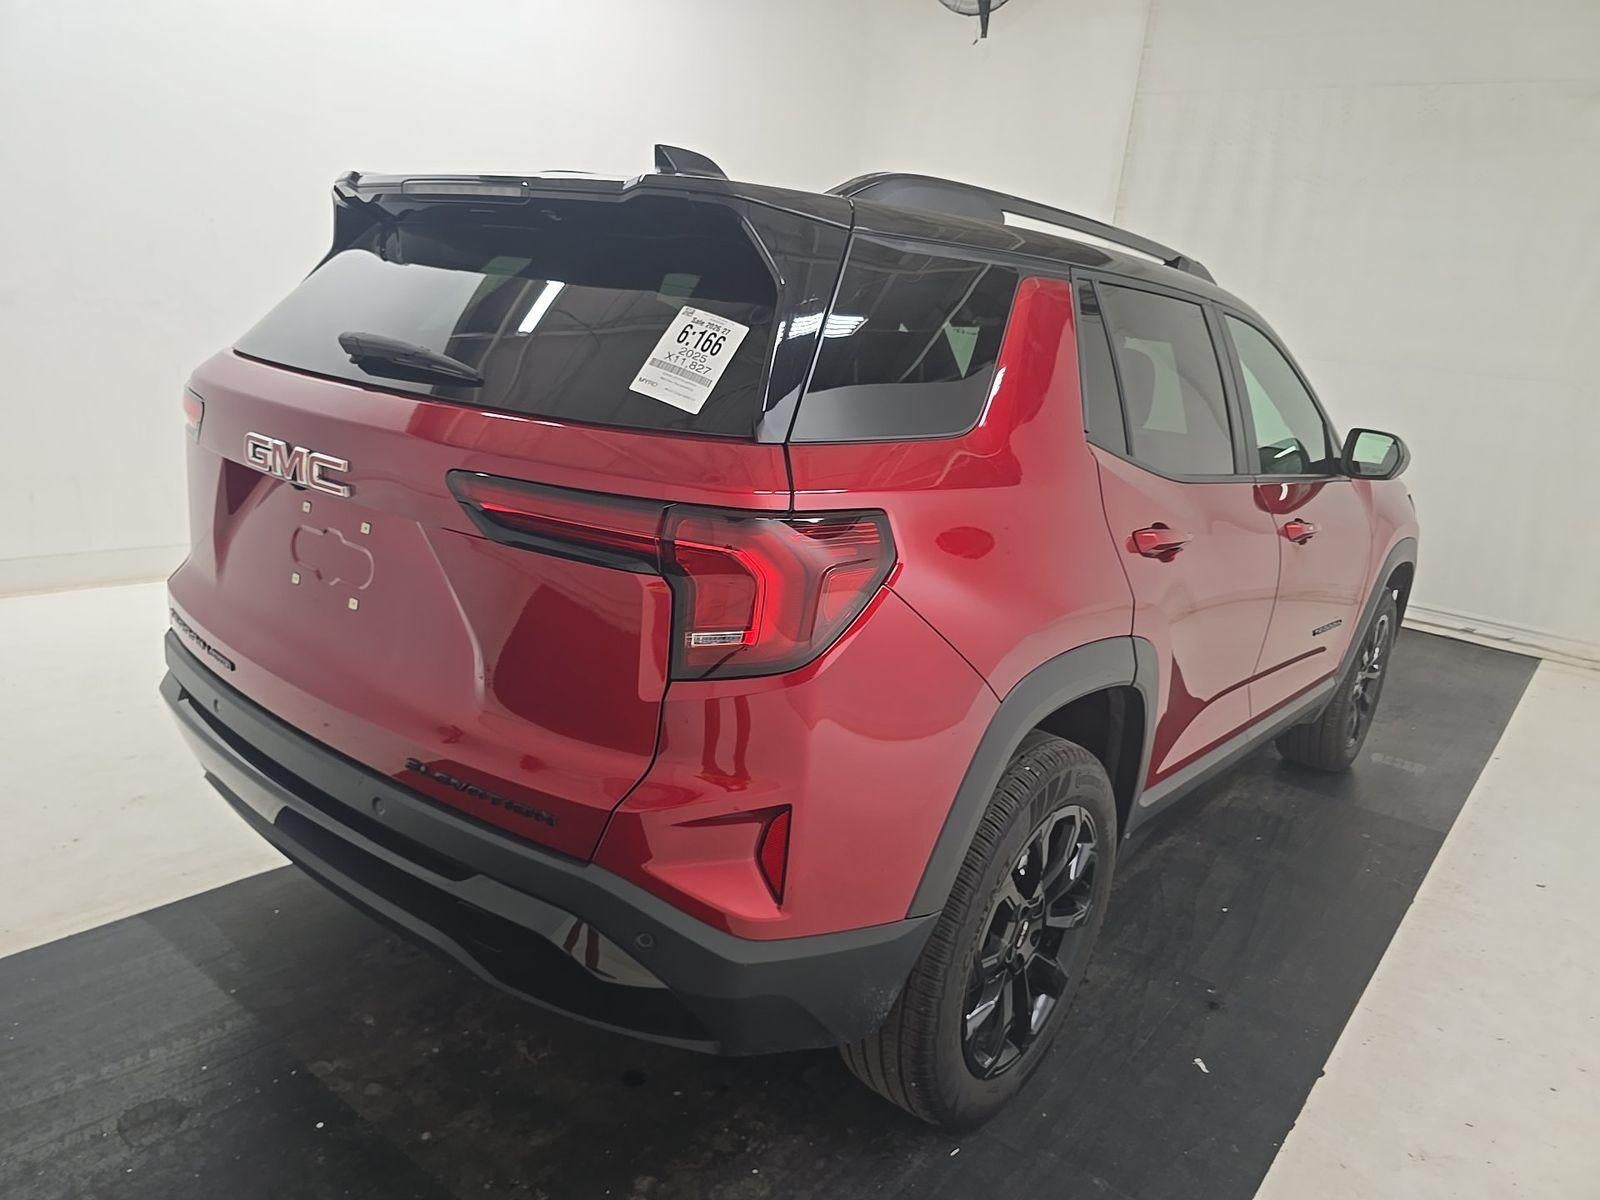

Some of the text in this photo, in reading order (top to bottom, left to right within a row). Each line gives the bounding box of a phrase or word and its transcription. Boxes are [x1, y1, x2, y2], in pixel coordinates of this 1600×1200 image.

[676, 324, 727, 356] 6:166
[678, 347, 709, 363] 2025
[244, 431, 352, 498] GMC
